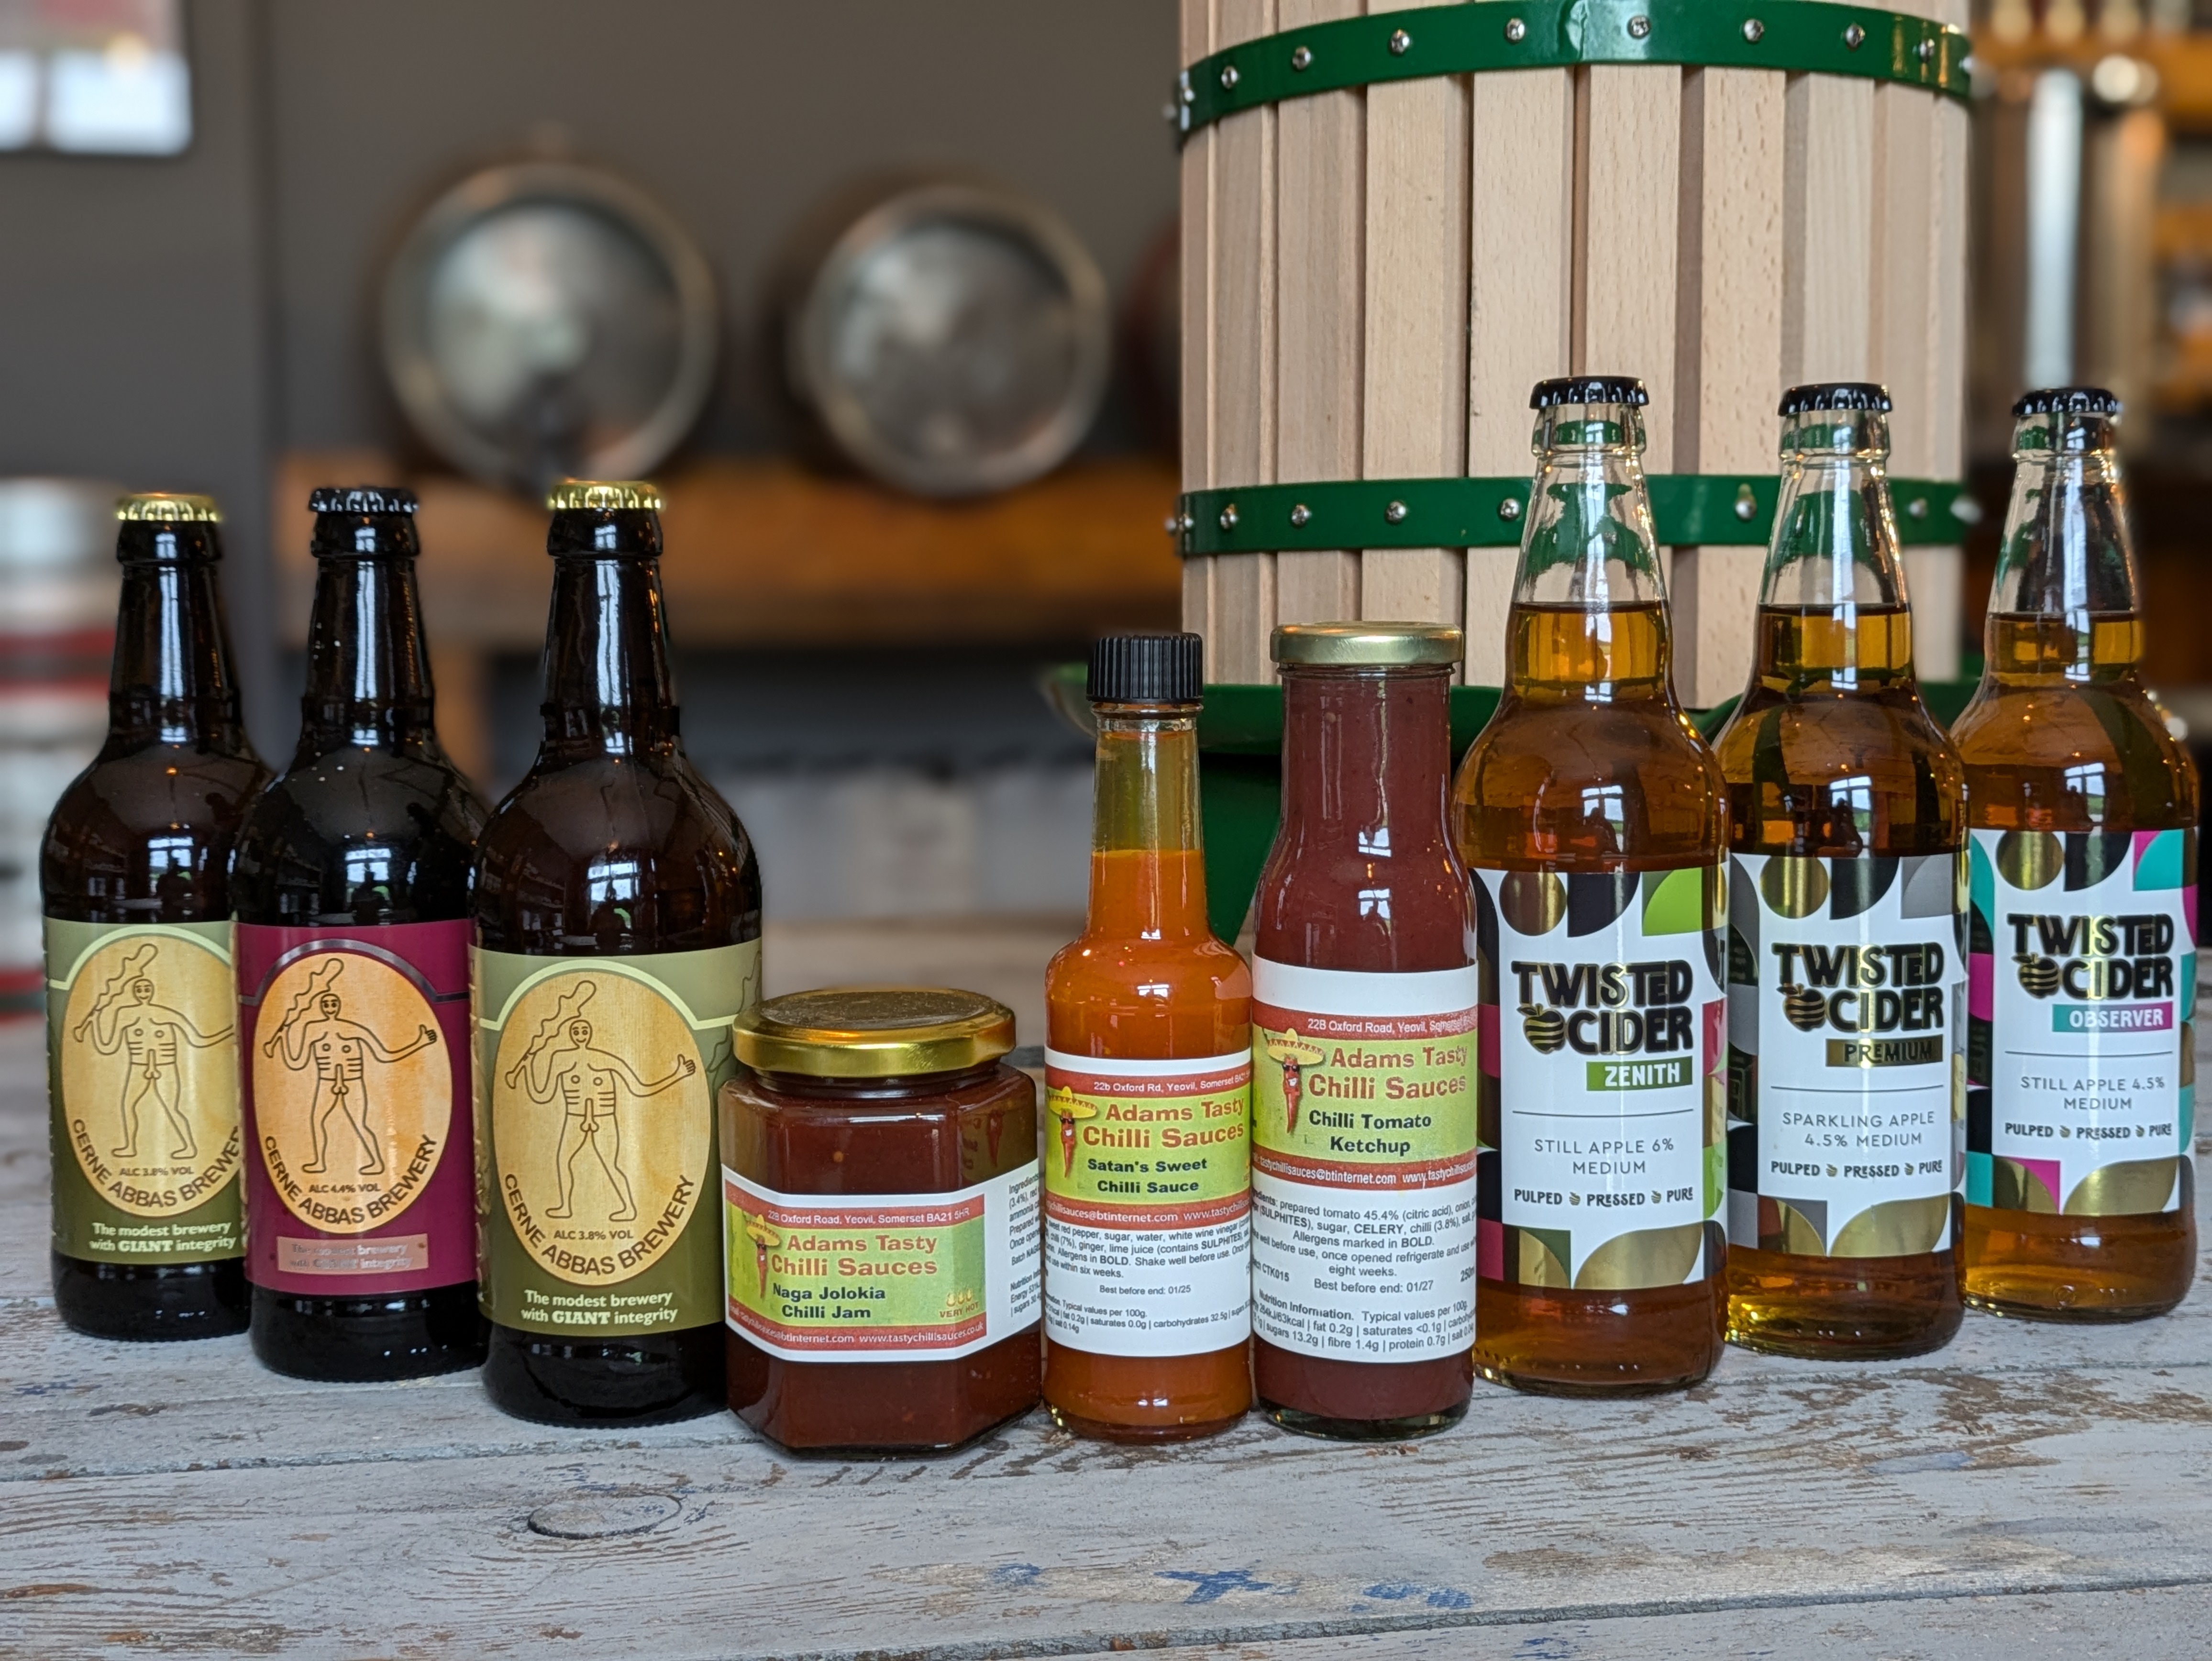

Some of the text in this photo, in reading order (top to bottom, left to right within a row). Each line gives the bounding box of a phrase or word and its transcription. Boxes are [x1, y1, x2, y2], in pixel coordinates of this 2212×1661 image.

[2007, 913, 2174, 957] TWISTED
[1771, 941, 1944, 988] TWISTED
[1511, 959, 1693, 1008] TWISTED
[2060, 955, 2173, 1000] CIDER
[1826, 986, 1944, 1033] CIDER
[2069, 1008, 2164, 1028] OBSERVER
[1308, 1018, 1326, 1030] 22B
[1328, 1020, 1362, 1032] Oxford
[1567, 1006, 1693, 1055] CIDER
[1330, 1045, 1467, 1068] Adams Tasty
[1844, 1040, 1932, 1063] PREMIUM
[1605, 1062, 1680, 1086] ZENITH
[2021, 1076, 2165, 1091] STILL APPLE 4.5%
[1113, 1077, 1234, 1092] Oxford Somerset
[1309, 1074, 1466, 1100] Chilli Sauces
[1106, 1098, 1243, 1122] Adams Tasty
[2063, 1097, 2132, 1110] MEDIUM
[1309, 1109, 1431, 1129] Chilli Tomato
[1782, 1111, 1935, 1128] SPARKLING APPLE
[1083, 1123, 1243, 1148] Chilli Sauces
[1804, 1132, 1922, 1147] 4.5% MEDIUM
[2005, 1123, 2172, 1140] PULPED PRESSED PURE
[1330, 1136, 1411, 1157] Ketchup
[1534, 1138, 1674, 1154] STILL APPLE 6%
[73, 1119, 177, 1207] CERNE ABBAS
[120, 1168, 140, 1176] ALC
[171, 1166, 194, 1175] VOL
[1088, 1158, 1207, 1173] Satan's Sweet
[1573, 1161, 1646, 1175] MEDIUM
[1771, 1159, 1942, 1178] PULPED PRESSED PURE
[265, 1134, 437, 1225] CERNE ABBAS BREWERY
[309, 1185, 329, 1193] ALC
[359, 1183, 381, 1192] VOL
[1097, 1180, 1199, 1193] Chilli Sauce
[1514, 1186, 1693, 1207] PULPED PRESSED PURE
[780, 1214, 812, 1224] Oxford
[878, 1214, 924, 1223] Somerset
[927, 1212, 952, 1222] BA21
[953, 1207, 970, 1219] 5HR
[1260, 1206, 1313, 1230] (SULPHITES),
[1410, 1222, 1431, 1233] chilli
[1280, 1201, 1429, 1221] prepared tomato 45.4% (citric
[92, 1222, 232, 1237] The modest brewery
[505, 1174, 694, 1275] CERNE ABBAS BREWERY
[1010, 1215, 1034, 1236] Prepared
[89, 1236, 236, 1252] with GIANT integrity
[554, 1230, 633, 1240] ALC 3.8% VOL
[1169, 1229, 1213, 1240] white wine
[1293, 1230, 1397, 1249] Allergens marked in
[787, 1235, 938, 1254] Adams Tasty
[1109, 1244, 1128, 1253] lime
[1131, 1245, 1153, 1255] juice
[1157, 1244, 1198, 1255] (contains
[1272, 1238, 1459, 1264] before once opened refrigerate and
[771, 1254, 938, 1276] Chilli Sauces
[1058, 1247, 1215, 1266] Allergens Shake well before
[1080, 1265, 1091, 1274] six
[1329, 1265, 1355, 1276] eight
[773, 1283, 885, 1302] Naga Jolokia
[1100, 1285, 1191, 1295] Best before 01/25
[1315, 1278, 1434, 1293] Best before 01/27
[524, 1289, 672, 1307] The modest brewery
[1259, 1288, 1287, 1309] Nutrition
[1362, 1311, 1401, 1323] Typical
[1404, 1310, 1435, 1321] values
[1438, 1306, 1450, 1319] per
[521, 1307, 678, 1326] with GIANT integrity
[782, 1305, 871, 1318] Chilli Jam
[940, 1302, 979, 1318] VERY HOT
[1062, 1300, 1082, 1312] Typical
[1084, 1306, 1107, 1315] values
[1109, 1309, 1123, 1318] per
[1091, 1317, 1209, 1328] saturates carbohydrates
[1313, 1320, 1413, 1337] fat 0.2g saturates
[859, 1322, 984, 1344] www.tastychillisauces.co.uk
[1293, 1330, 1445, 1352] 13.2g fibre 1.4g protein 0.7g
